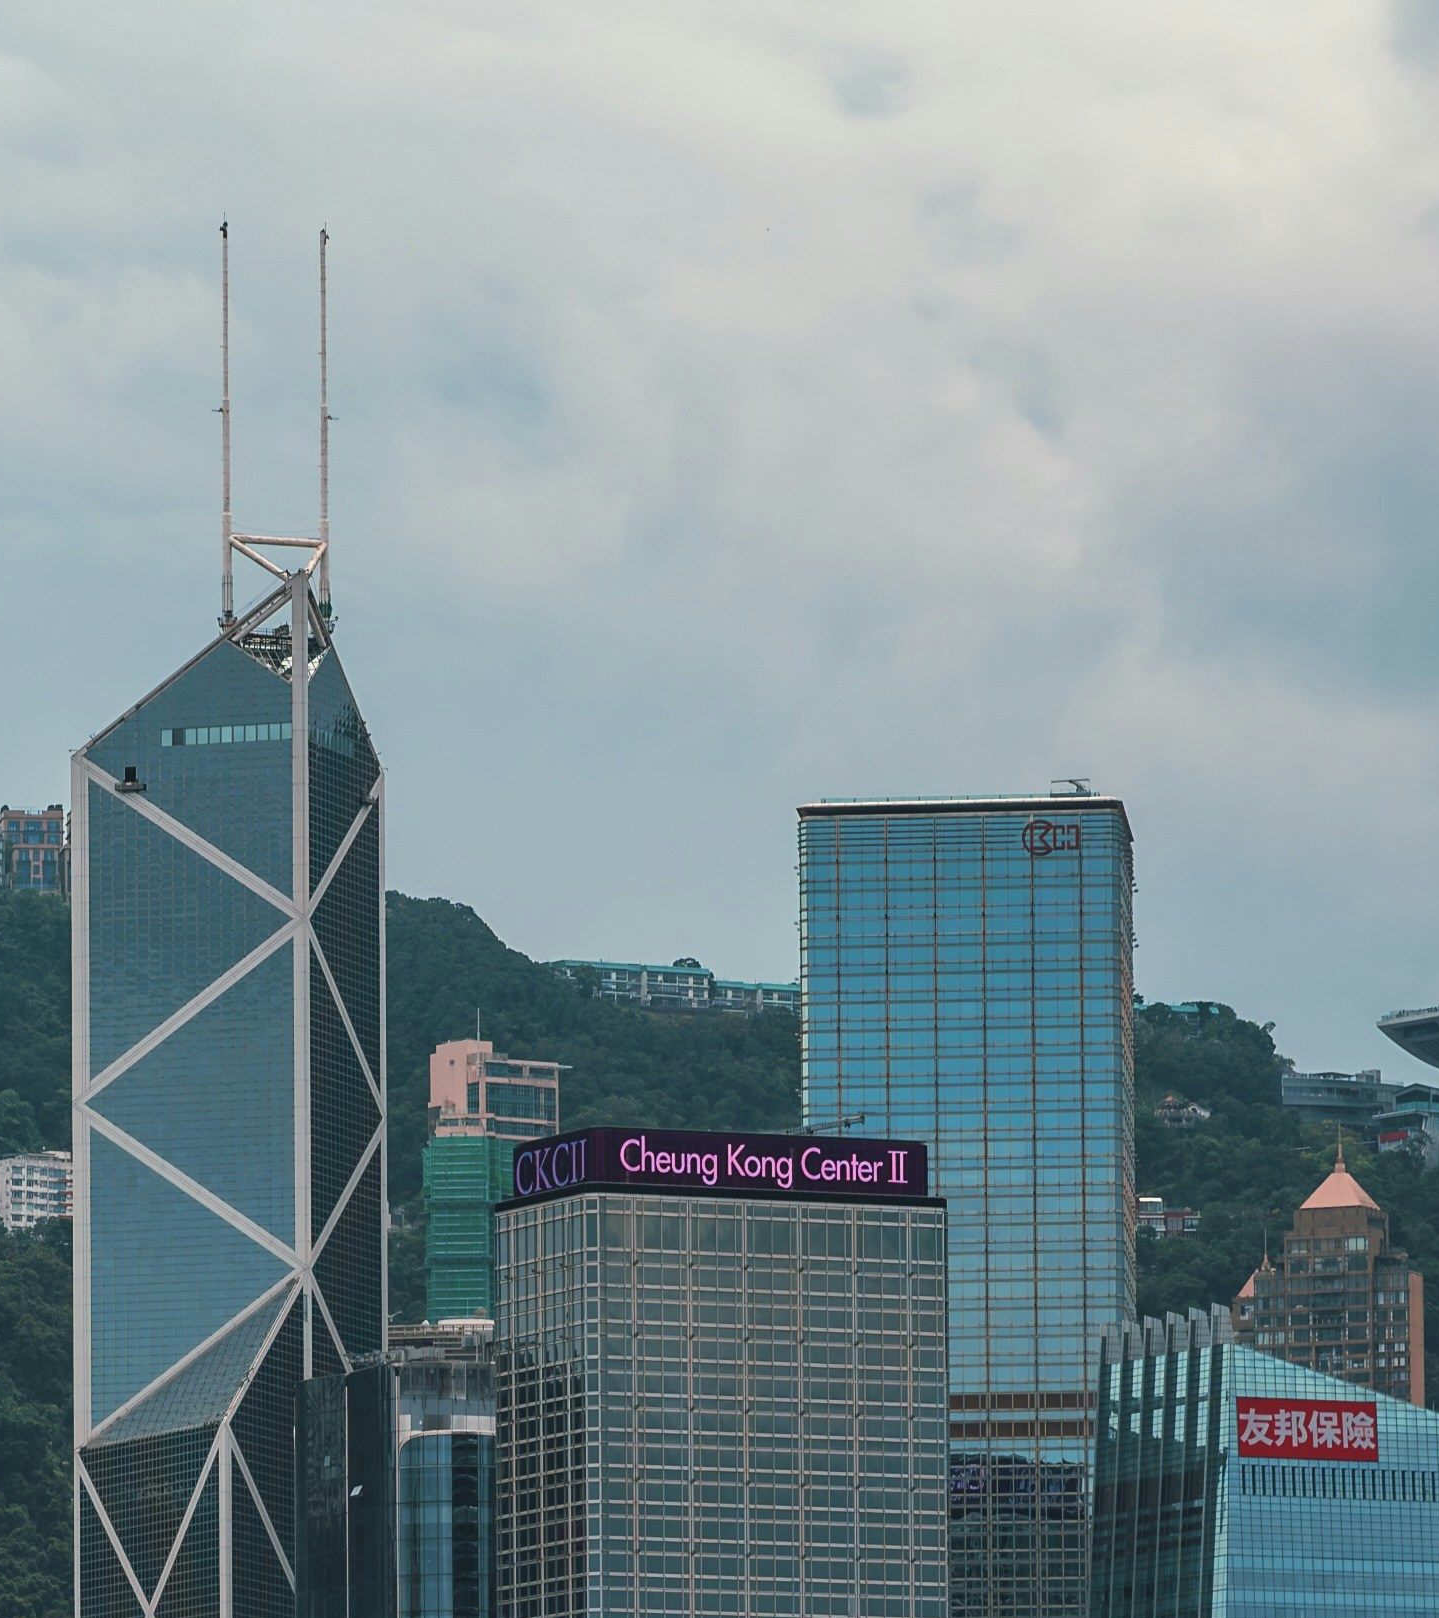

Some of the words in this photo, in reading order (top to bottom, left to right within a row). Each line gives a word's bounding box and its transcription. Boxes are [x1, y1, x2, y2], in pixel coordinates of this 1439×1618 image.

[620, 1135, 718, 1185] Cheung
[727, 1144, 792, 1188] Kong
[801, 1147, 883, 1183] Center
[1239, 1408, 1376, 1450] 友邦保險
